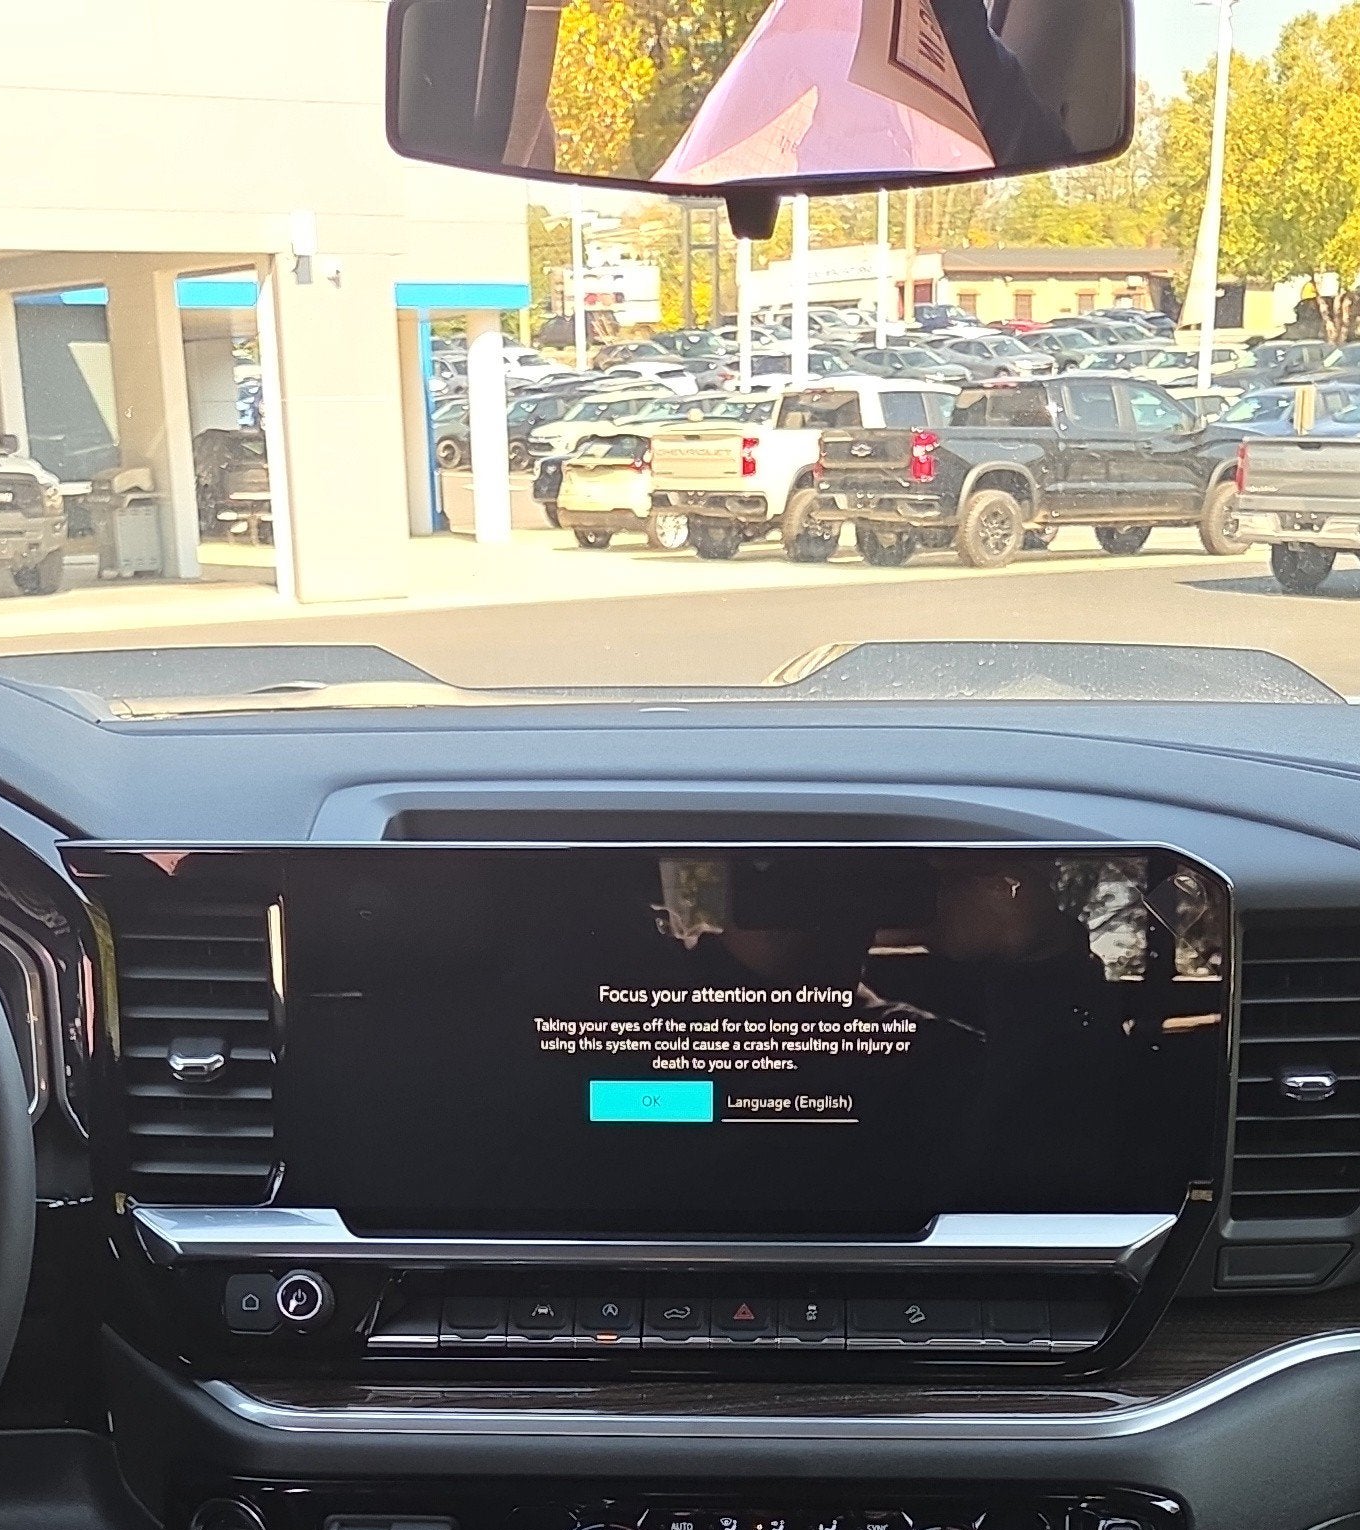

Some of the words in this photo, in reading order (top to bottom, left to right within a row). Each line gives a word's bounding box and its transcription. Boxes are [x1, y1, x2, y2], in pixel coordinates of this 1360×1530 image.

[599, 985, 648, 1003] Focus
[651, 990, 688, 1008] your
[691, 985, 767, 1003] attention
[770, 989, 792, 1003] on
[795, 985, 853, 1008] driving
[534, 1017, 577, 1035] Taking
[578, 1021, 608, 1035] your
[610, 1021, 640, 1035] eyes
[642, 1017, 664, 1032] off
[665, 1018, 686, 1032] the
[689, 1018, 719, 1032] road
[722, 1018, 742, 1032] for
[744, 1020, 766, 1033] too
[769, 1018, 799, 1035] long
[801, 1022, 816, 1033] or
[818, 1020, 841, 1033] too
[843, 1018, 879, 1033] often
[882, 1018, 917, 1033] while
[540, 1037, 576, 1053] using
[578, 1036, 603, 1050] this
[605, 1038, 652, 1054] system
[654, 1036, 690, 1050] could
[692, 1040, 730, 1051] cause
[732, 1040, 740, 1051] a
[743, 1037, 779, 1051] crash
[782, 1037, 838, 1054] resulting
[841, 1038, 853, 1051] in
[856, 1038, 893, 1055] injury
[895, 1041, 911, 1051] or
[652, 1055, 689, 1069] death
[692, 1057, 706, 1069] to
[708, 1059, 732, 1073] you
[734, 1059, 749, 1069] or
[751, 1056, 799, 1070] others.
[641, 1095, 663, 1108] OK
[727, 1095, 791, 1112] Language
[794, 1094, 854, 1112] (English)
